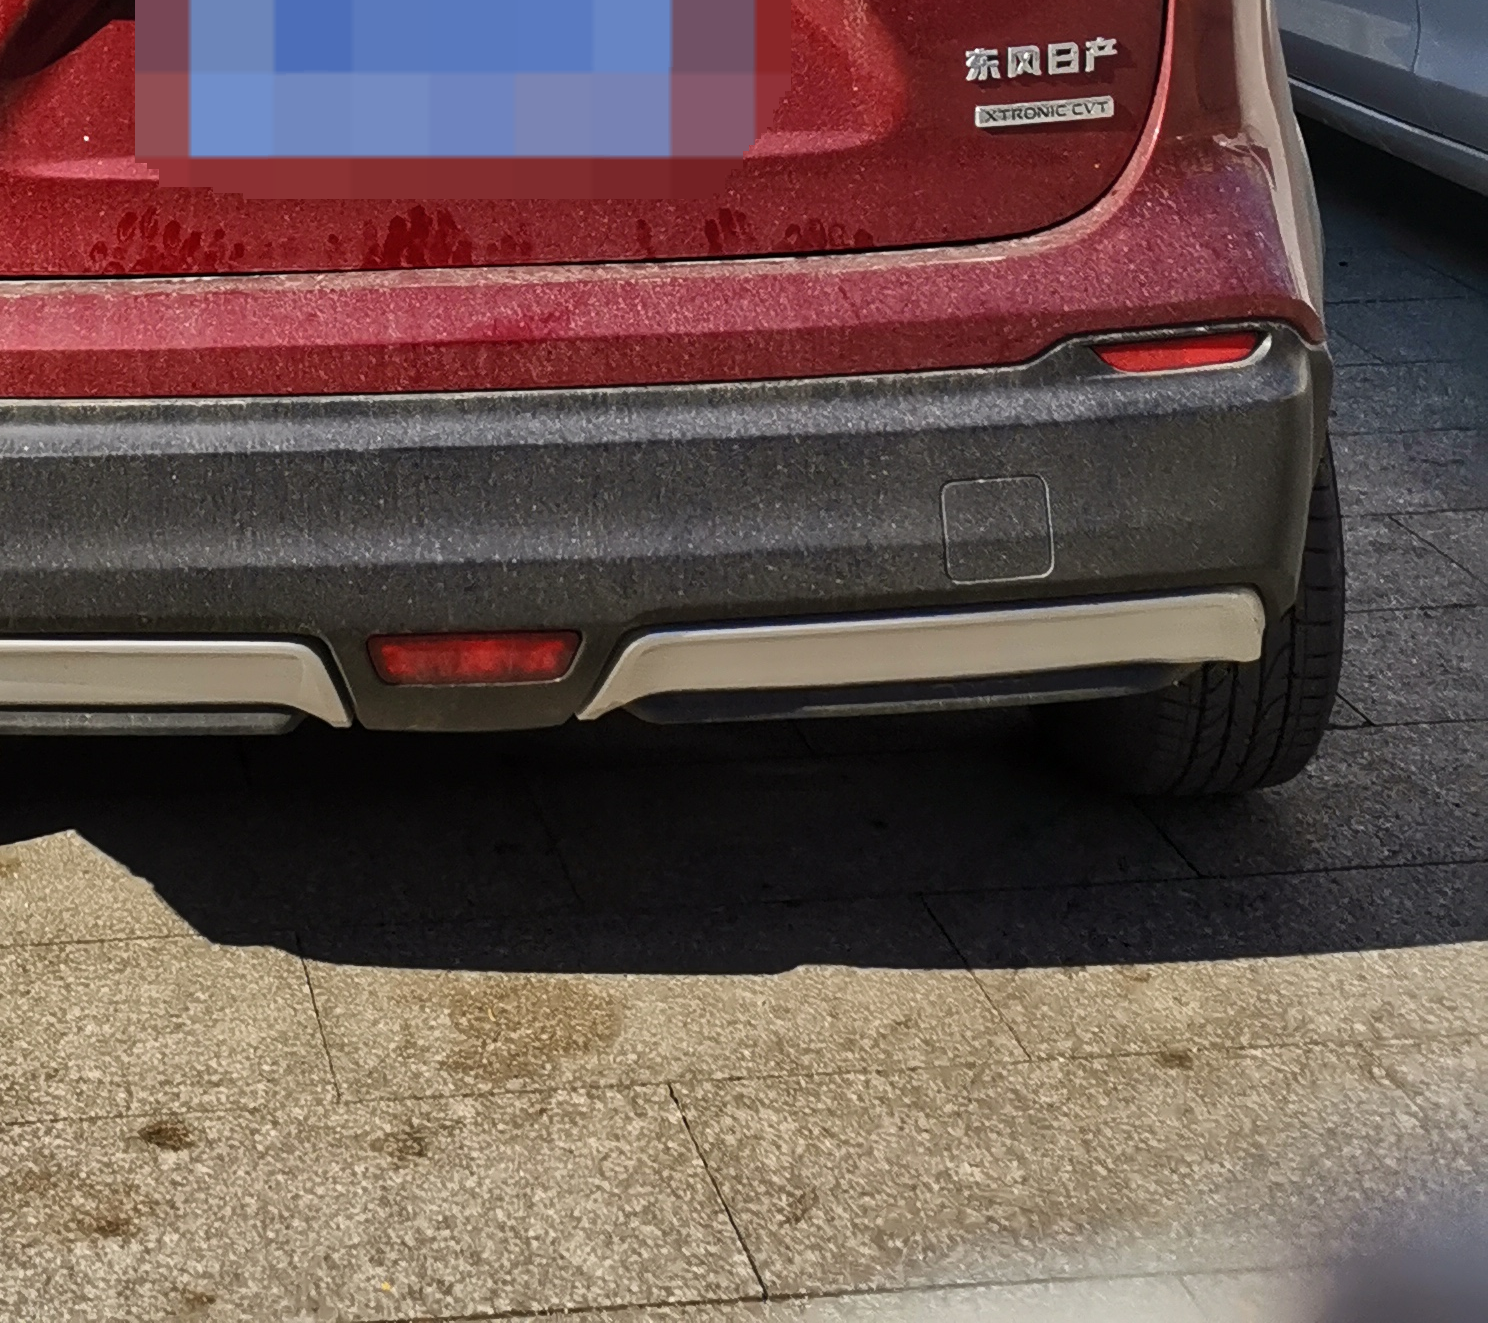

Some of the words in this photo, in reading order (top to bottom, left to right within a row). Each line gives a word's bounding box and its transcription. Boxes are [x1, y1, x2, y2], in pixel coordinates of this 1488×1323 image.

[965, 36, 1118, 82] 东风日产
[984, 103, 1068, 124] XTRONIC
[1071, 100, 1109, 117] CVT
